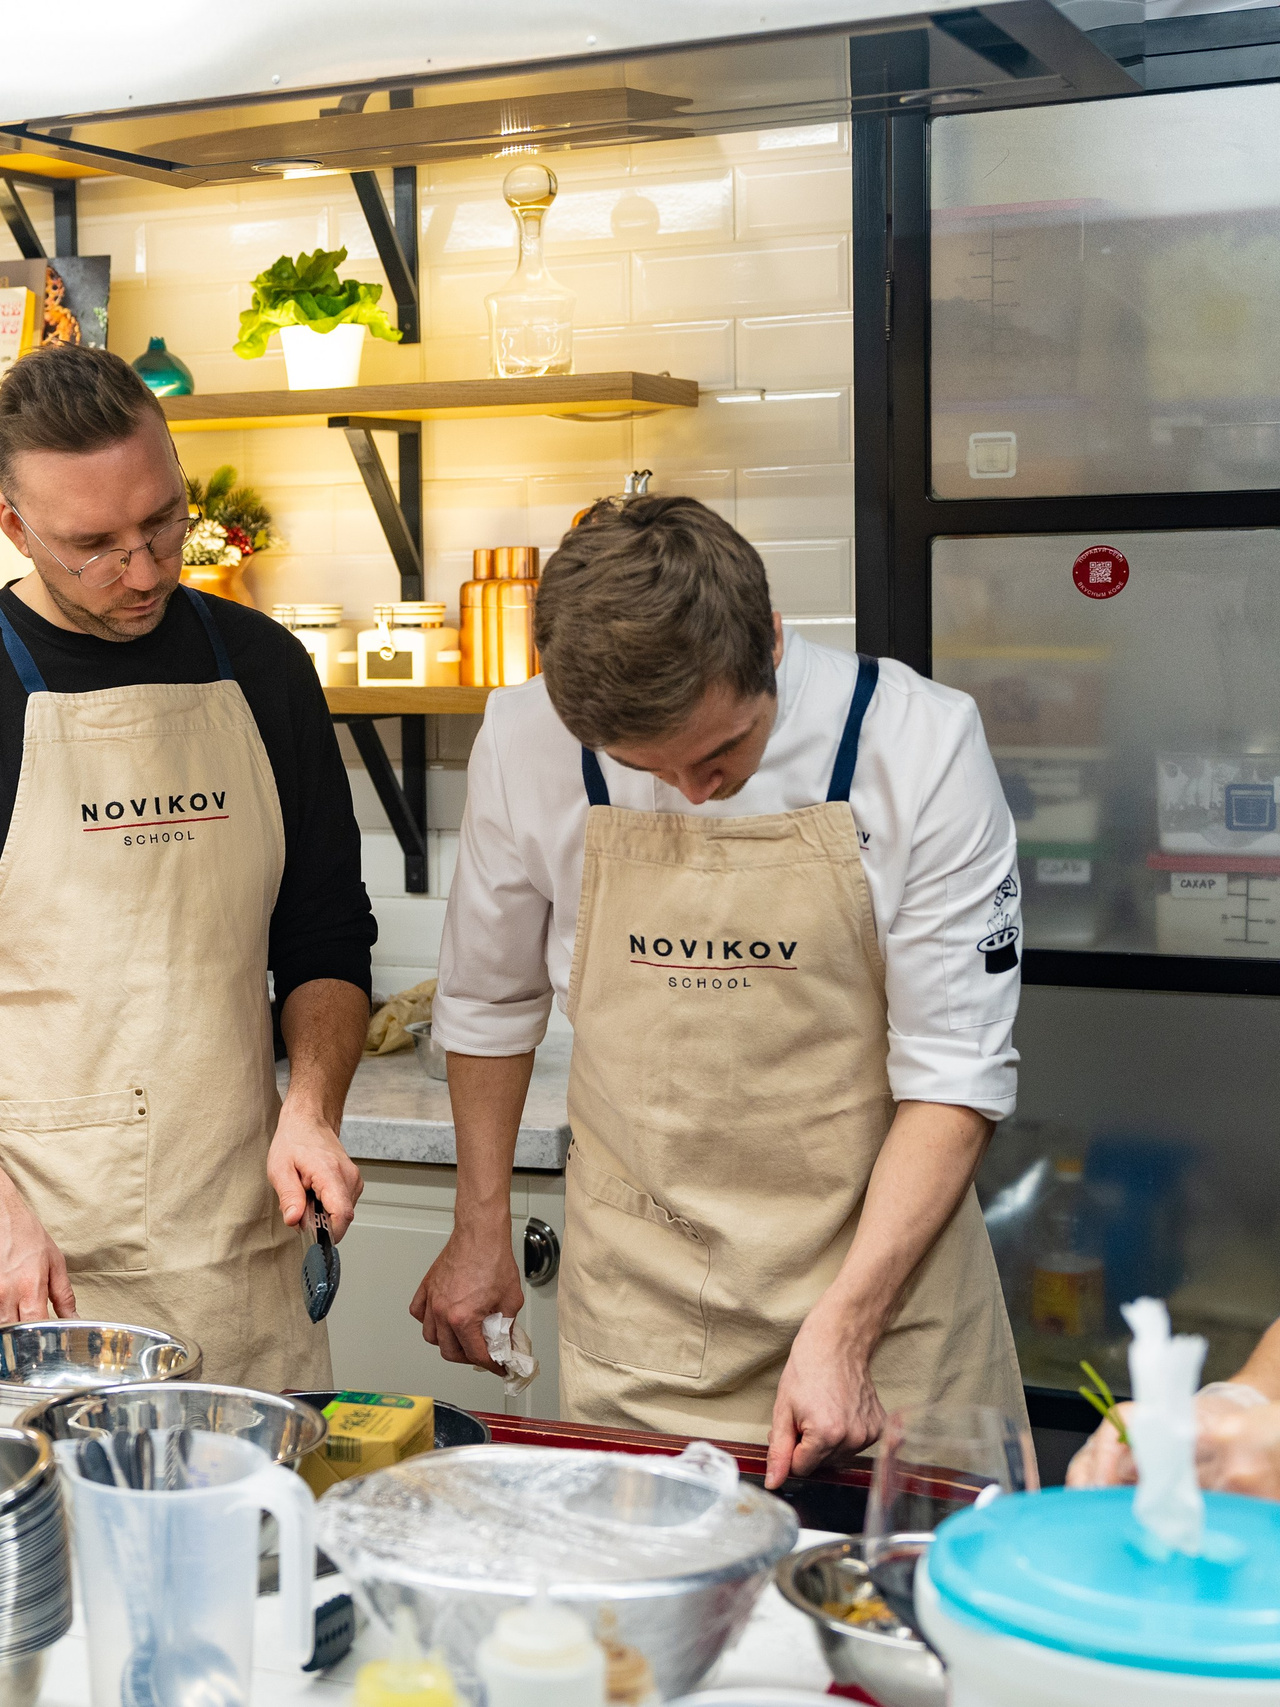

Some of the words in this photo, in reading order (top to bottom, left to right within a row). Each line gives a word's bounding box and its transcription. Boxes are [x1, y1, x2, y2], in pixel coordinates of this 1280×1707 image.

[1077, 581, 1107, 598] ВКУСНЫМ
[1107, 581, 1124, 596] КОФЕ
[81, 791, 226, 822] NOVIKOV
[123, 830, 195, 846] SCHOOL
[1180, 879, 1216, 889] САХАР
[629, 934, 798, 960] NOVIKOV
[668, 977, 752, 989] SCHOOL
